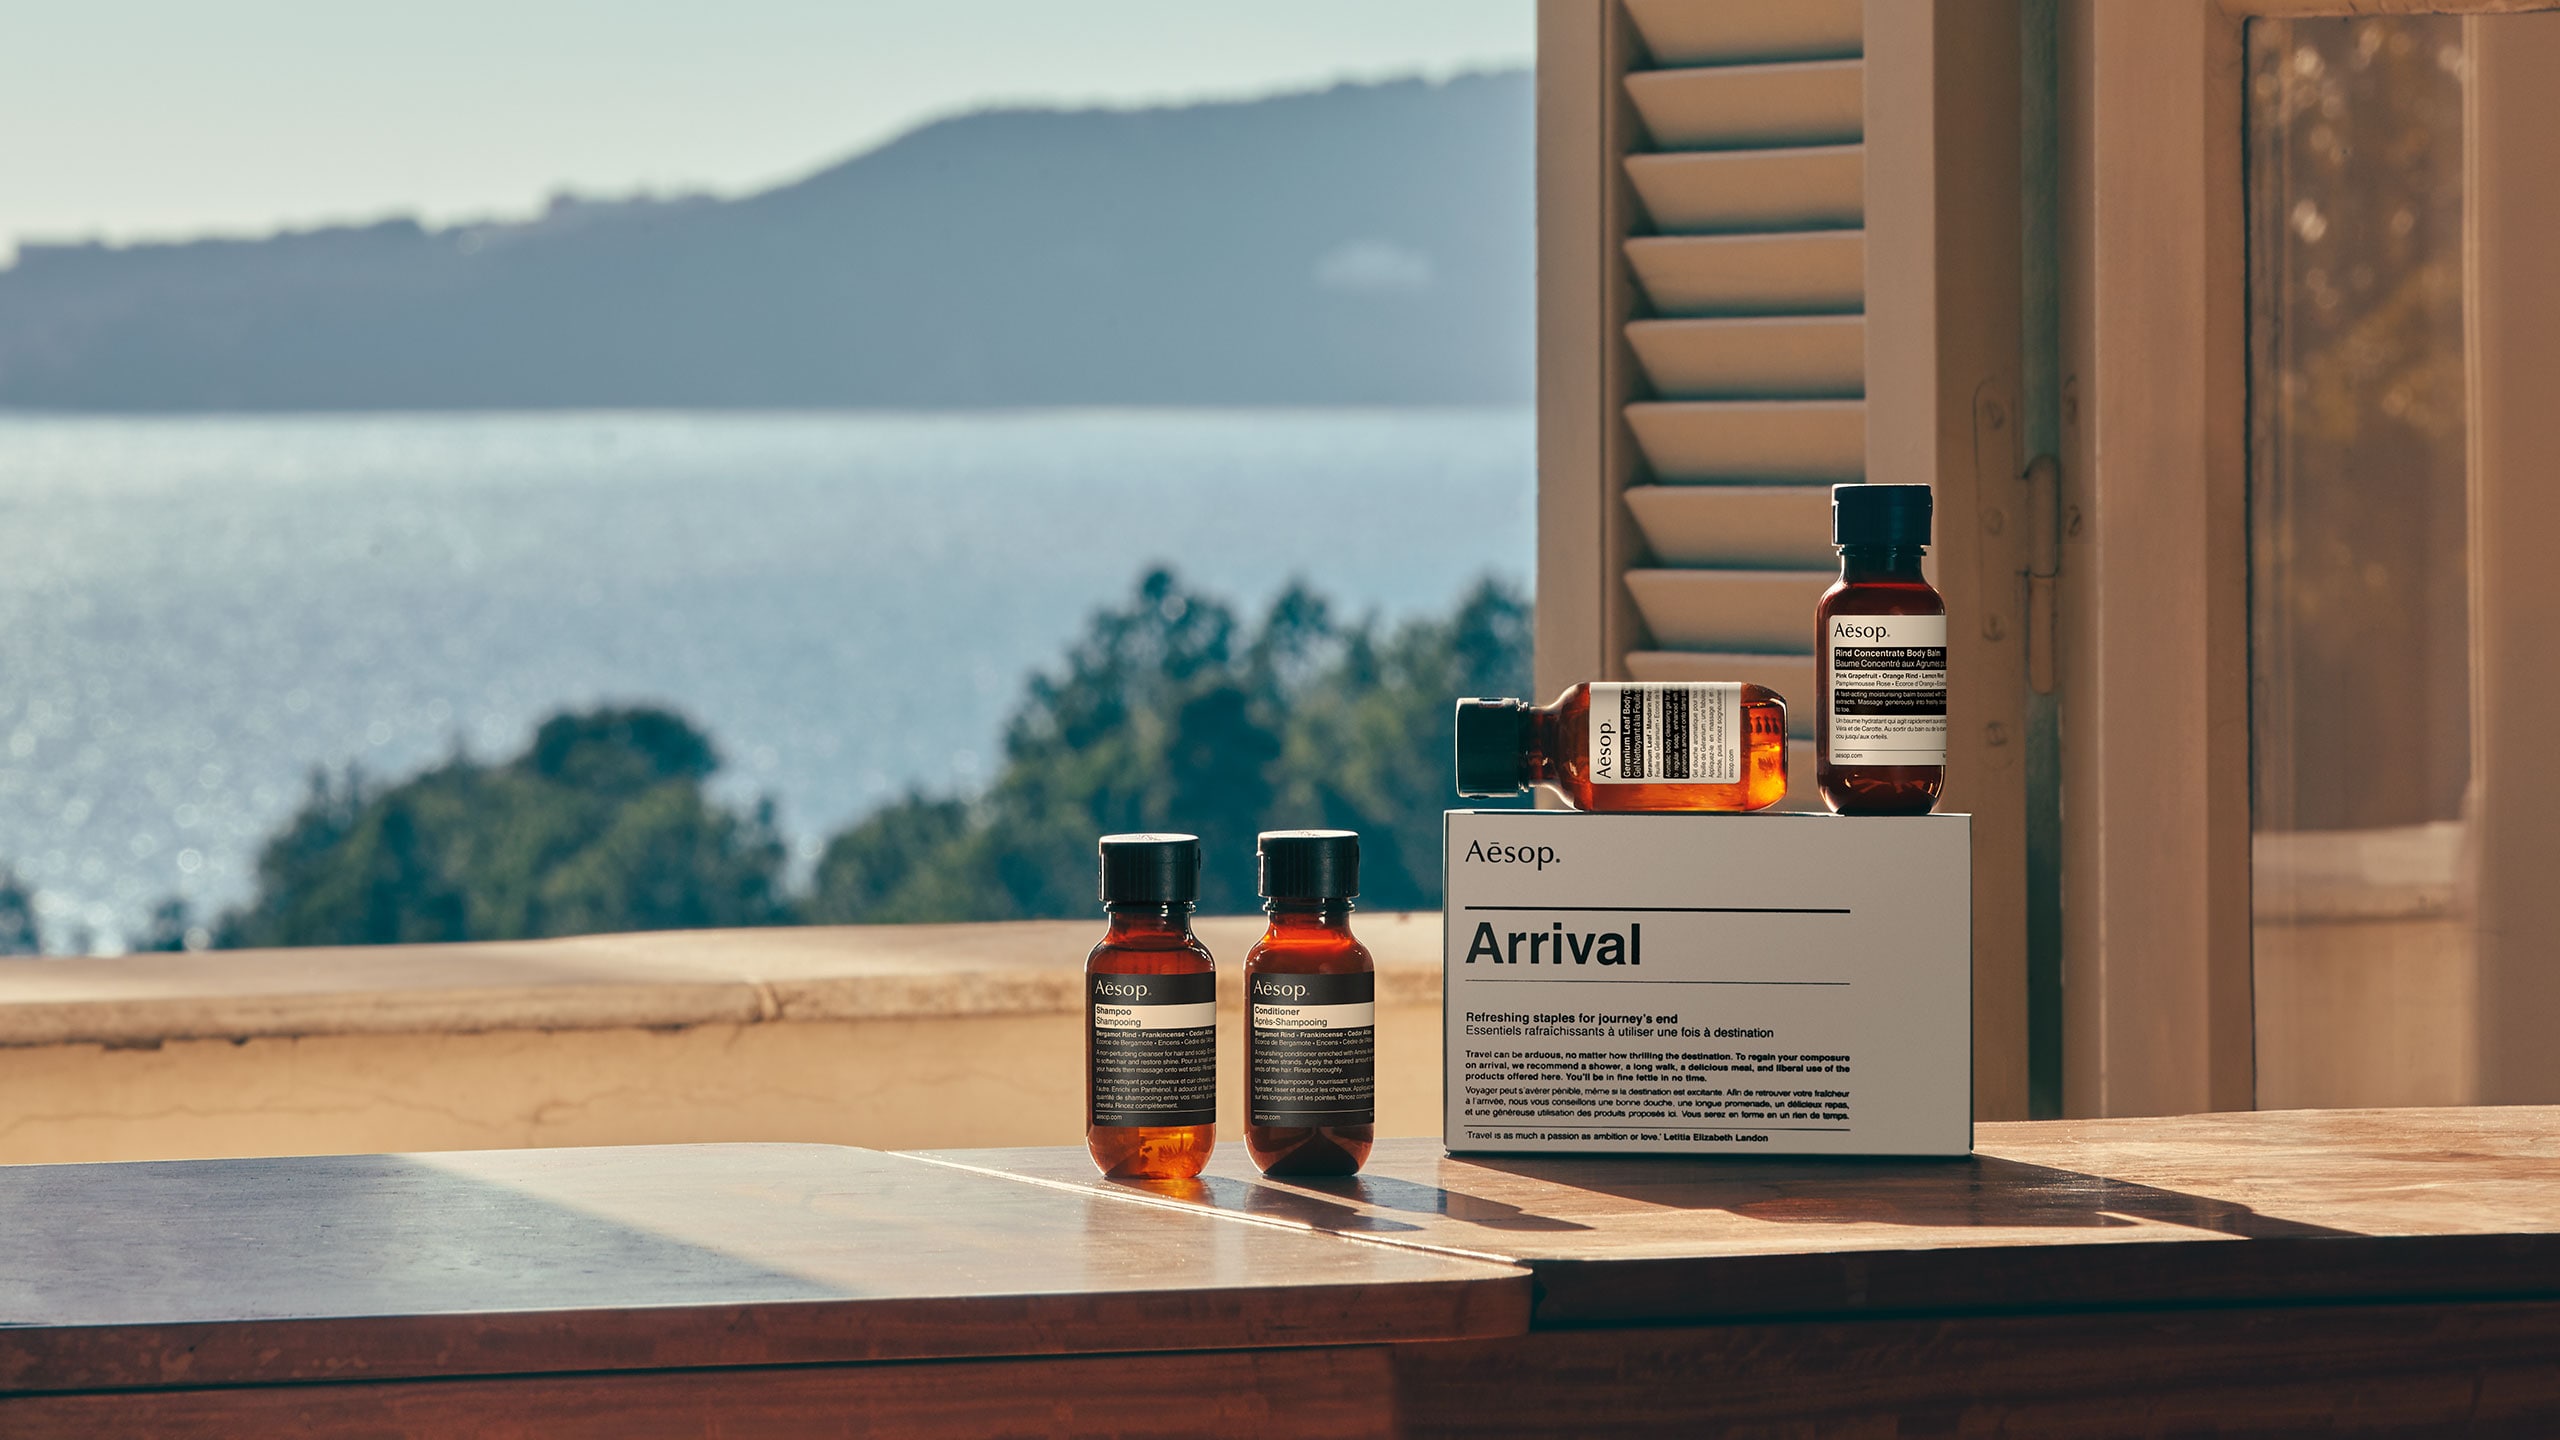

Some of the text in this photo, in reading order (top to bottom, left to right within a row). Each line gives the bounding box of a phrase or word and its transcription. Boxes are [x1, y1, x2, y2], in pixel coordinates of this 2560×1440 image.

[1907, 649, 1926, 658] Body
[1861, 659, 1900, 667] Concentré
[1623, 696, 1632, 777] Geranium Leaf Body
[1633, 728, 1642, 764] Nettoyant
[1465, 840, 1560, 871] Aēsop.
[1466, 922, 1640, 964] Arrival
[1096, 1006, 1131, 1016] Shampoo
[1255, 1006, 1300, 1015] Conditioner
[1096, 1017, 1141, 1027] Shampooing
[1255, 1018, 1327, 1027] Après-Shampooing
[1466, 1012, 1677, 1025] Refreshing staples for journey's end
[1466, 1025, 1521, 1035] Essentiels
[1608, 1026, 1614, 1036] à
[1618, 1027, 1654, 1036] utiliser
[1657, 1029, 1678, 1037] une
[1681, 1027, 1700, 1037] fois
[1704, 1027, 1710, 1037] à
[1714, 1027, 1774, 1038] destination
[1465, 1050, 1492, 1058] Travel
[1524, 1051, 1563, 1059] arduous,
[1629, 1052, 1663, 1061] thrilling
[1665, 1052, 1679, 1060] the
[1748, 1053, 1776, 1062] regain
[1777, 1054, 1798, 1062] your
[1799, 1055, 1850, 1063] composure
[1633, 1063, 1652, 1072] long
[1655, 1063, 1678, 1071] walk,
[1730, 1064, 1754, 1072] meal,
[1757, 1064, 1774, 1072] and
[1776, 1064, 1803, 1072] liberal
[1465, 1073, 1504, 1081] products
[1566, 1073, 1590, 1081] You'll
[1547, 1133, 1579, 1141] passion
[1663, 1133, 1690, 1141] Letitia
